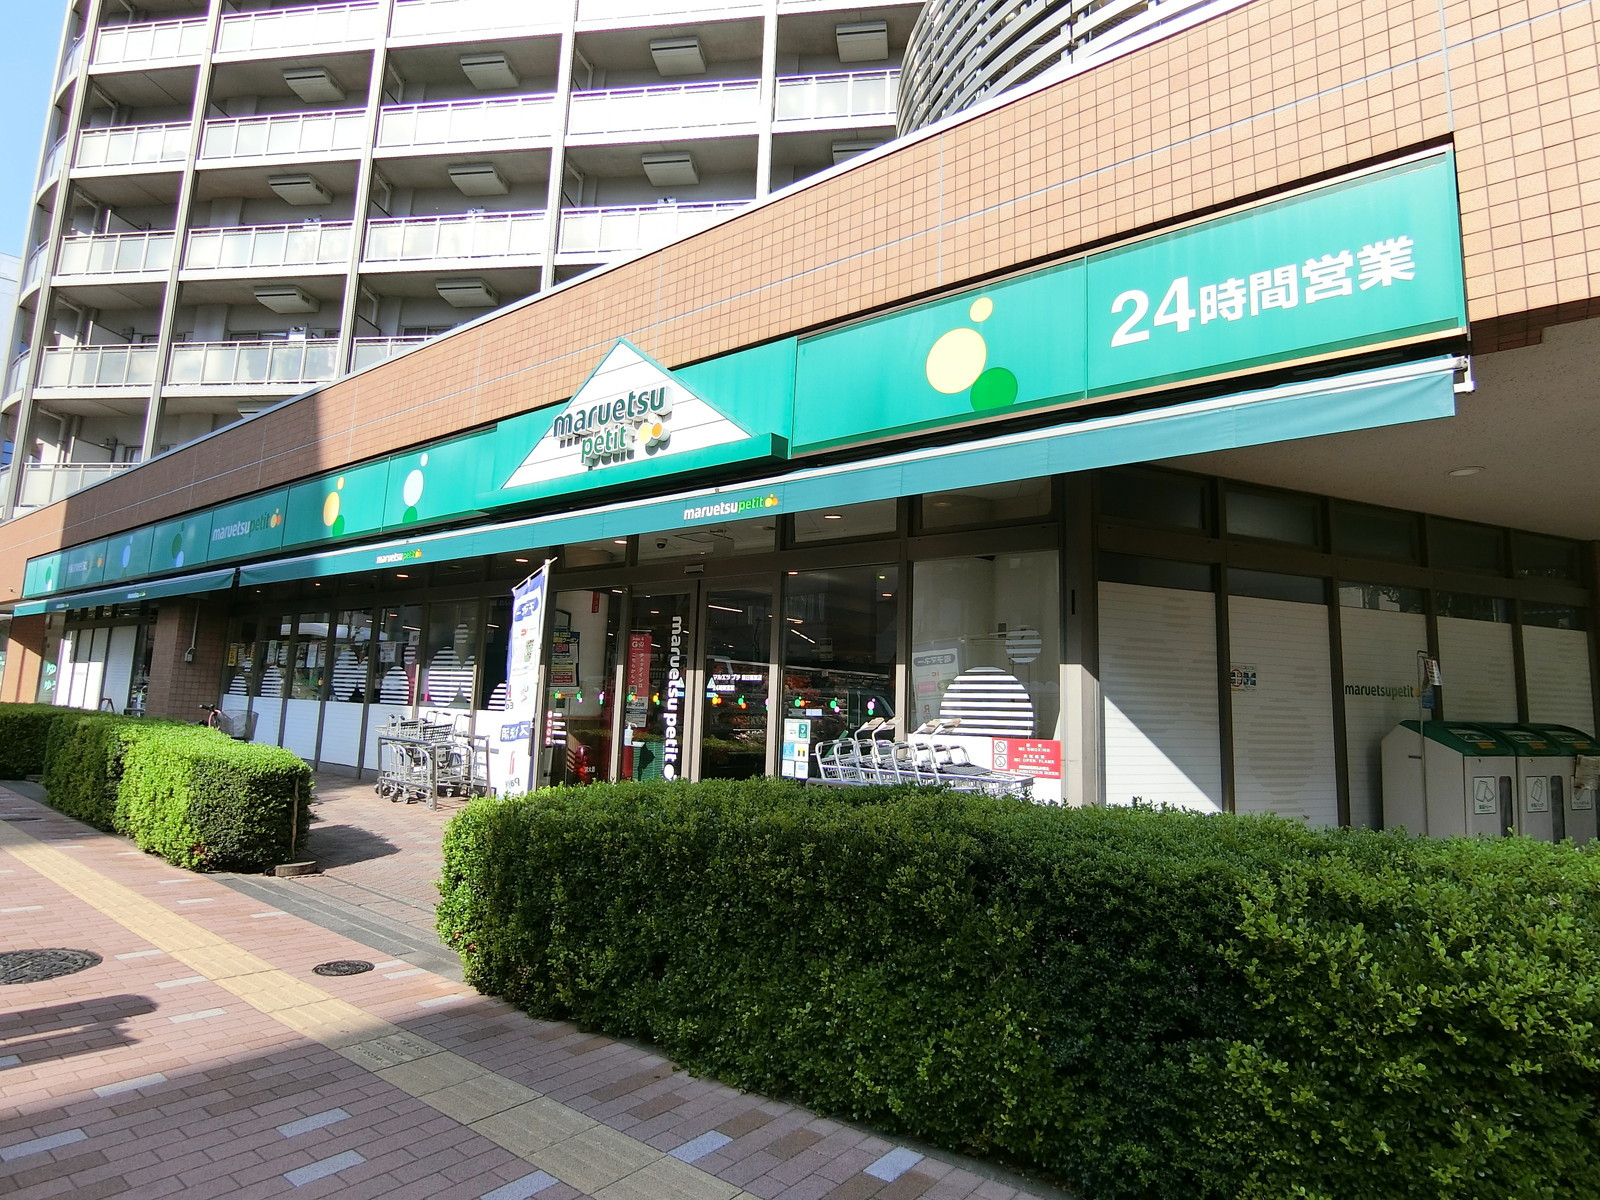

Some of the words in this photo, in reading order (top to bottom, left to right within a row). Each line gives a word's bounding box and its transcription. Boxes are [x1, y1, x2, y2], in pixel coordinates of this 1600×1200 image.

[1110, 235, 1415, 347] 24時間営業
[553, 386, 667, 438] maruetsu
[581, 424, 627, 464] petit
[667, 615, 682, 711] maruetsu
[1345, 685, 1414, 700] maruetsupetit
[663, 712, 679, 762] petit
